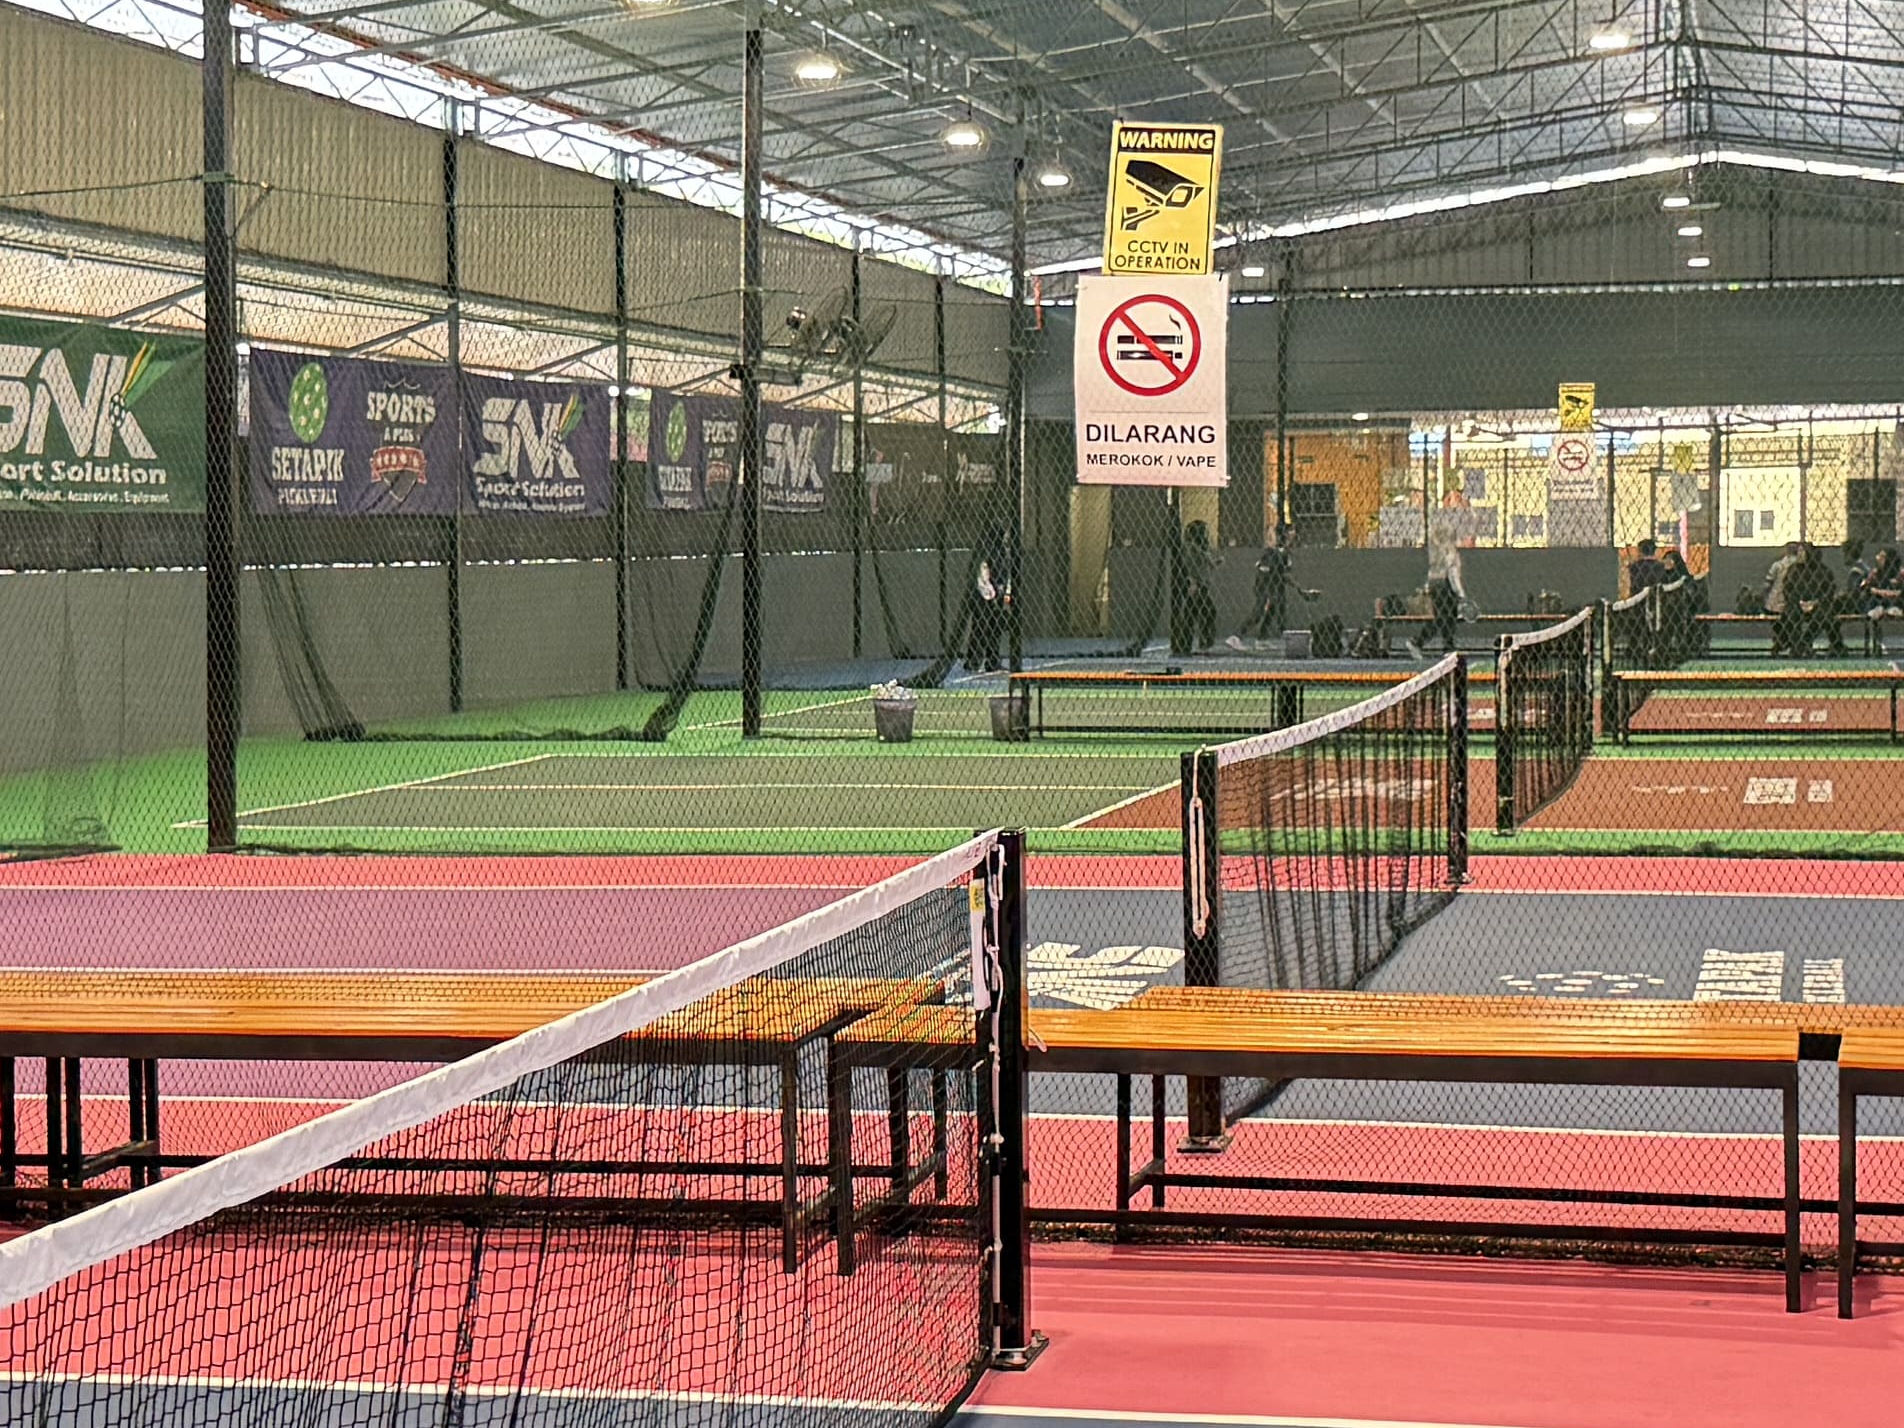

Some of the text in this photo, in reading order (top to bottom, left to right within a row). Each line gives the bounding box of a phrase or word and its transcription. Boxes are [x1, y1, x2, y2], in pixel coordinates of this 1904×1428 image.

[1120, 130, 1214, 150] WARNING
[1127, 240, 1189, 254] CCTV IN
[1114, 254, 1200, 271] OPERATION
[366, 391, 437, 423] SPORTS
[473, 396, 584, 479] SNK
[1086, 424, 1216, 444] DILARANG
[1086, 453, 1164, 467] MEROKOK
[1177, 455, 1217, 468] VAPE
[51, 460, 167, 484] Solution
